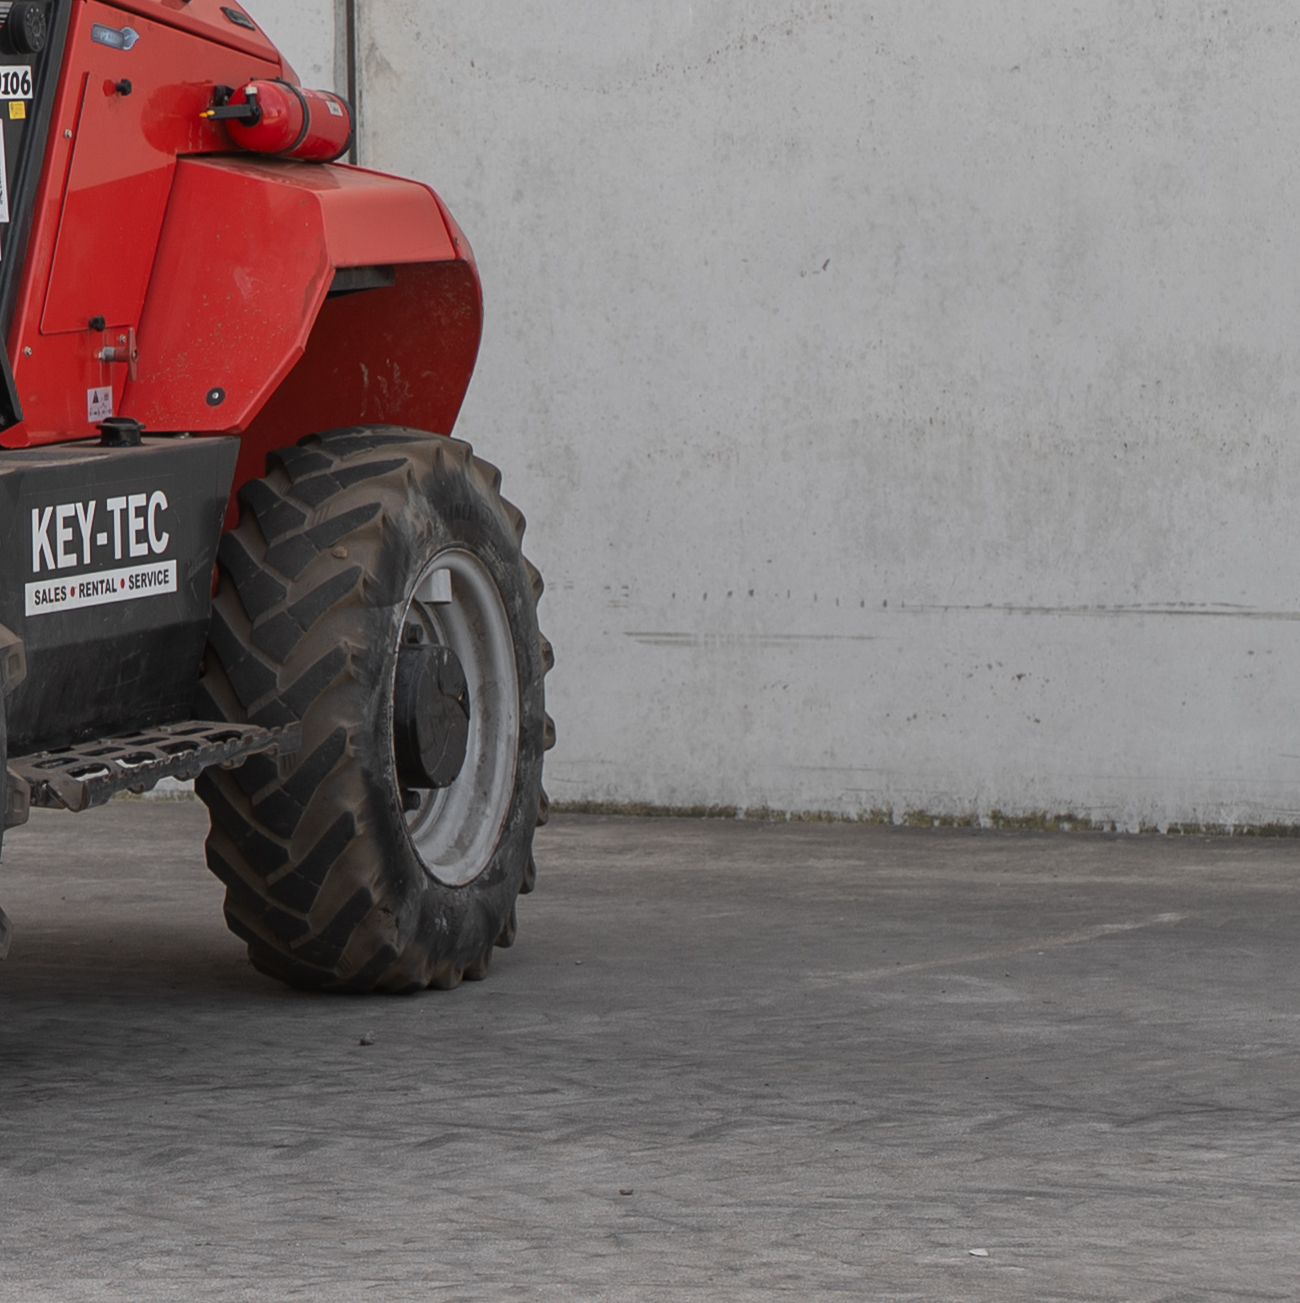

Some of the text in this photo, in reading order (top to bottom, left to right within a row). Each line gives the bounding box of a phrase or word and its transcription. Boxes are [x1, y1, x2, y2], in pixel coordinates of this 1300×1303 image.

[31, 490, 170, 573] KEY-TEC
[34, 569, 169, 605] SALES RENTAL SERVICE
